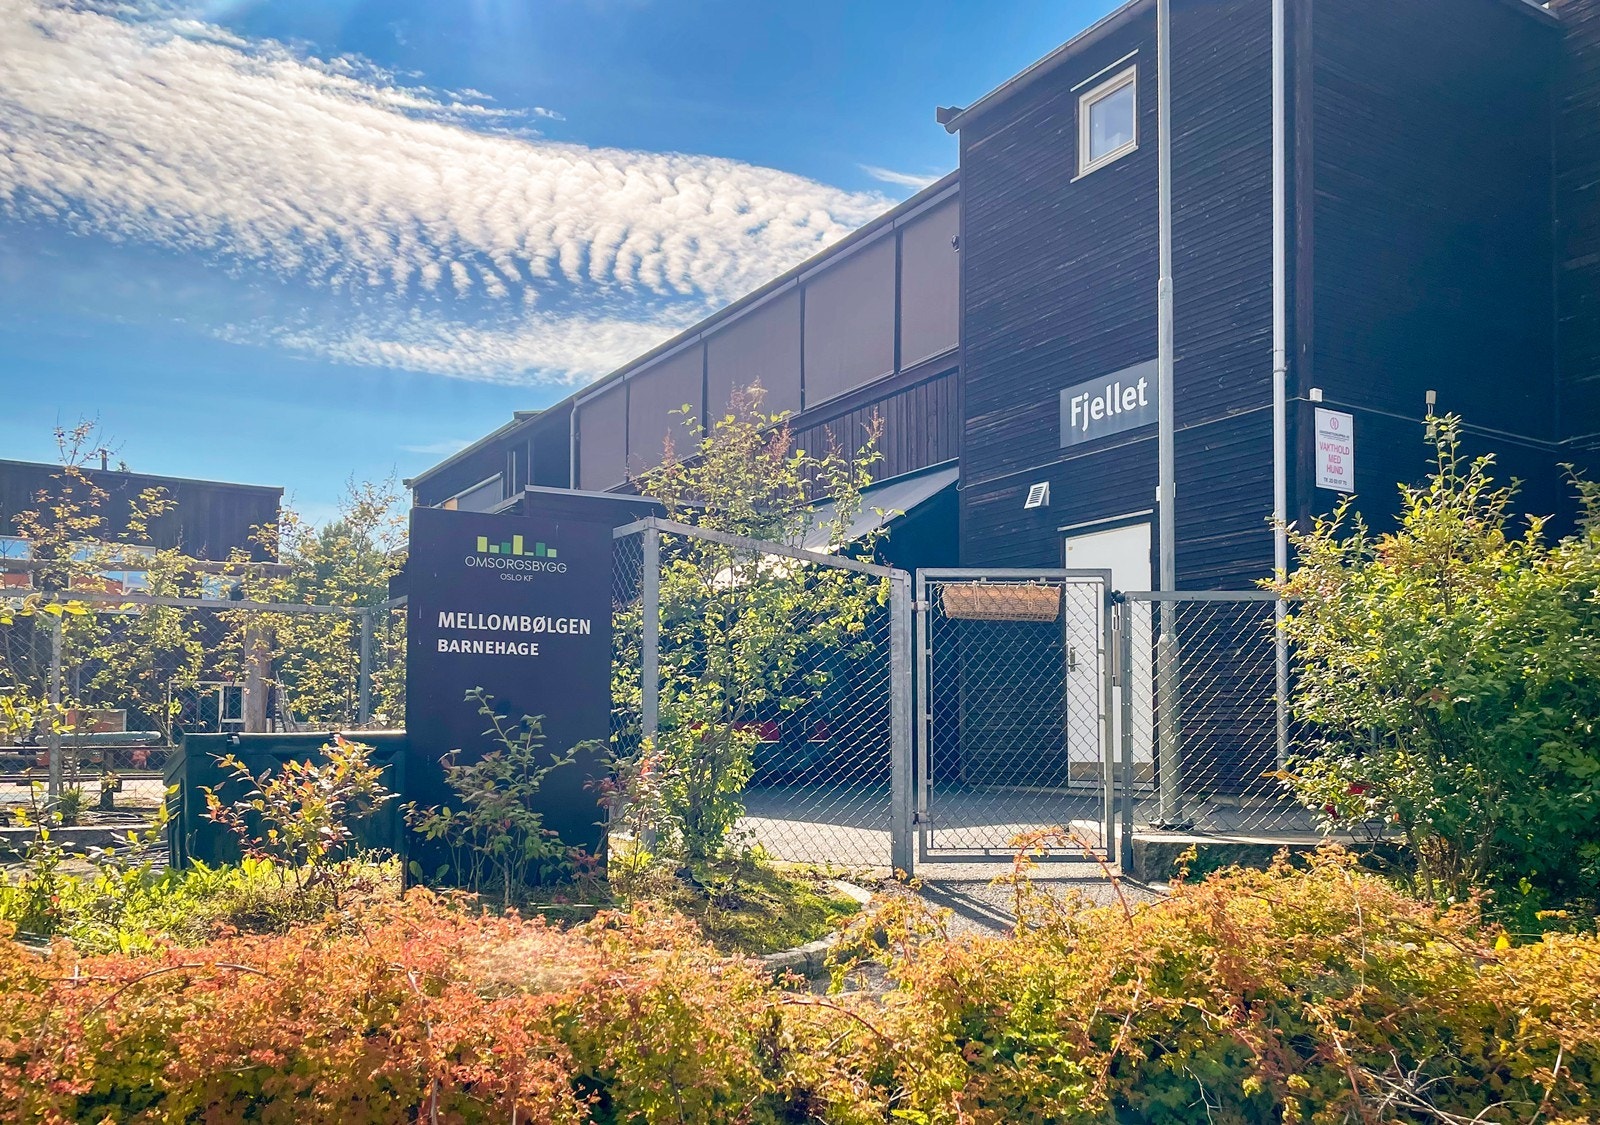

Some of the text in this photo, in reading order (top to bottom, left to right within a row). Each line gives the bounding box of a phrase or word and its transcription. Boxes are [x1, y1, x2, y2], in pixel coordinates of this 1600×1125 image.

[1071, 377, 1148, 431] Fjellet
[1319, 442, 1350, 455] VAKTHOLD
[1328, 454, 1341, 463] MED
[1326, 464, 1343, 475] HUND
[464, 555, 567, 573] OMSORGSBYGG
[500, 573, 522, 581] OSLO
[438, 611, 591, 635] MELLOMBØLGEN
[437, 639, 539, 655] BARNEHAGE
